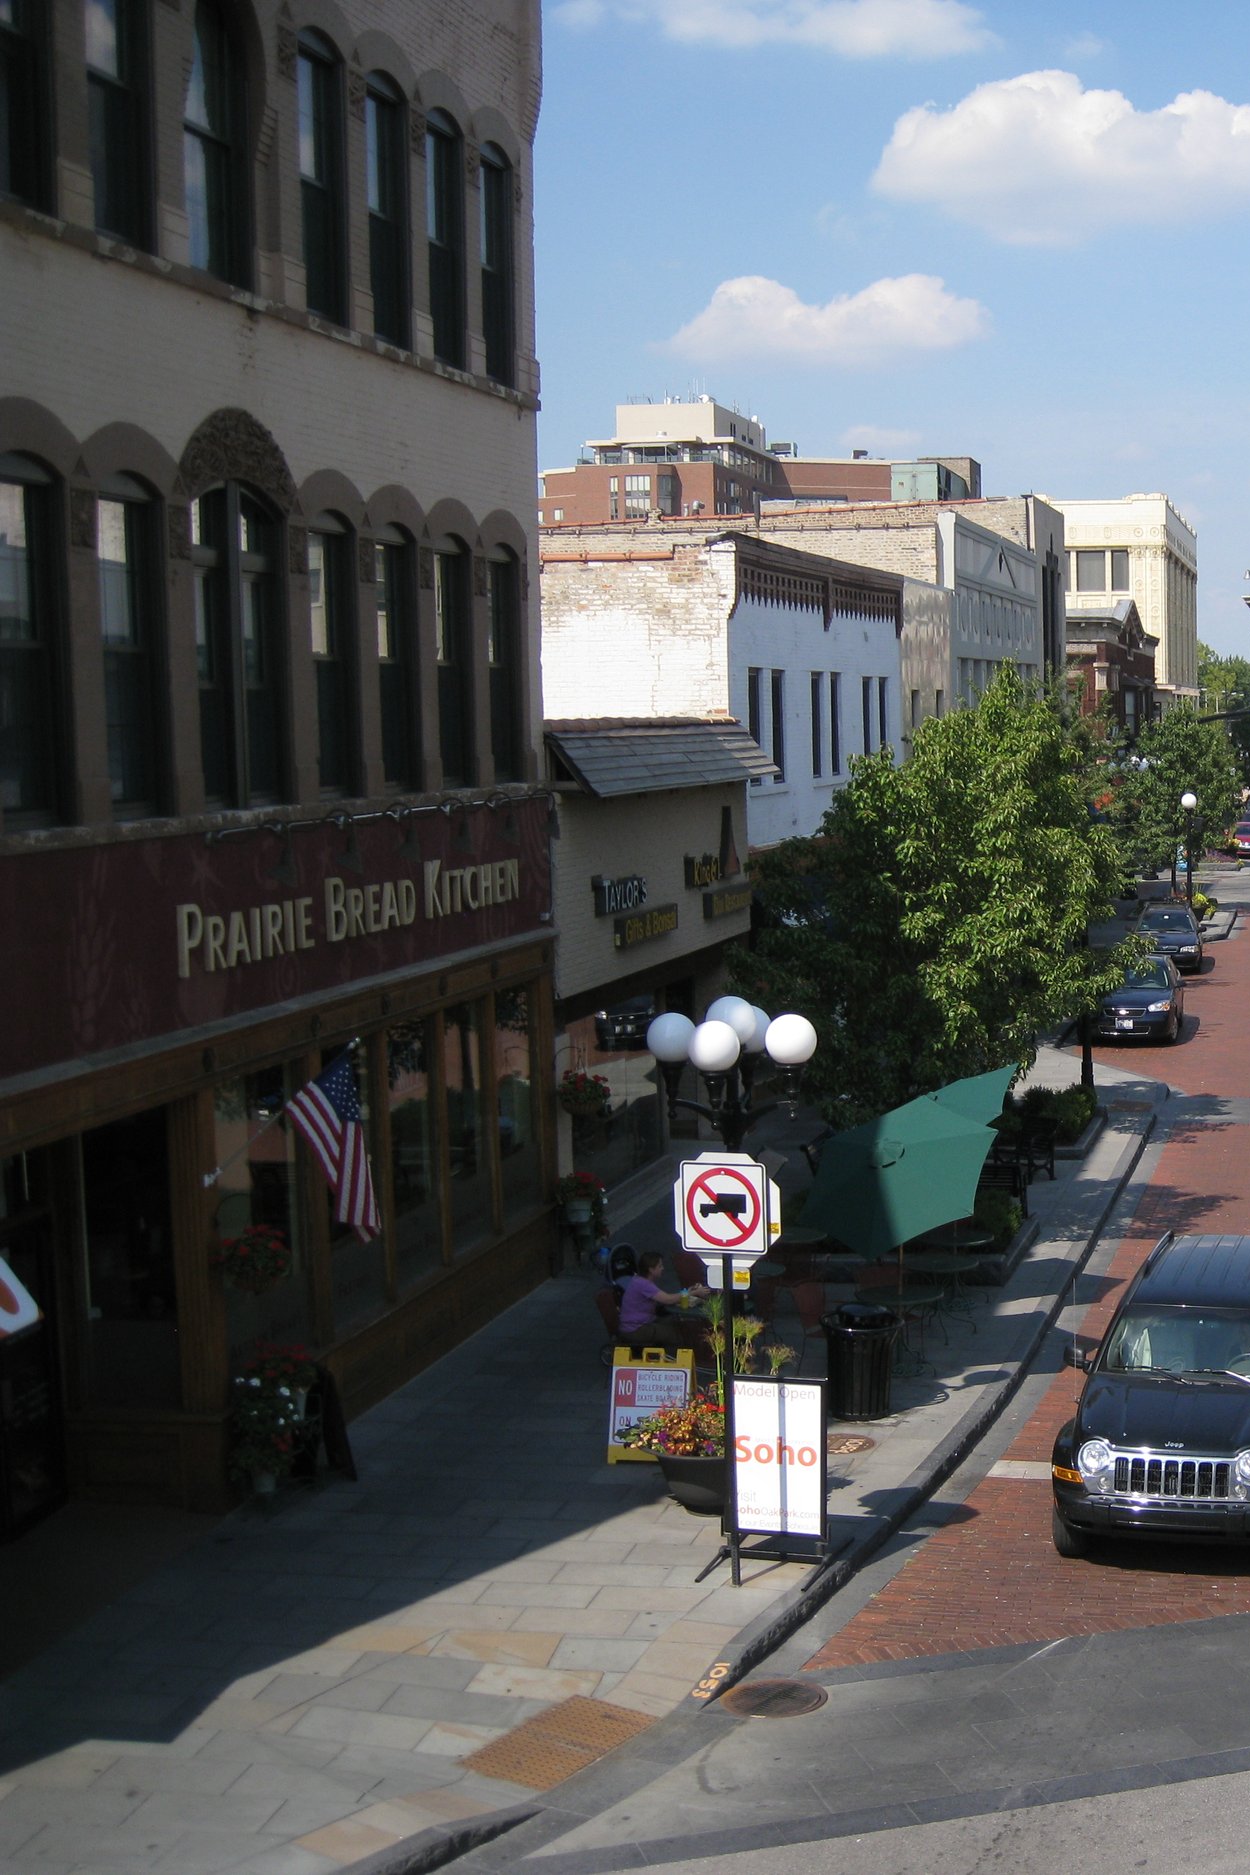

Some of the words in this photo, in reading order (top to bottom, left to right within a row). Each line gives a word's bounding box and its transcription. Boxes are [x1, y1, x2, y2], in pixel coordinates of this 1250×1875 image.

[603, 878, 648, 914] TAYLOR'S
[176, 897, 315, 979] PRAIRIE
[325, 876, 416, 942] BREAD
[424, 858, 519, 920] KITCHEN
[626, 918, 643, 944] Gifts
[645, 914, 652, 937] &
[638, 1373, 662, 1381] BICYCLE
[618, 1379, 633, 1396] NO
[638, 1384, 684, 1392] ROLLERBLADING
[734, 1383, 775, 1398] Model
[780, 1386, 816, 1401] Open
[619, 1416, 632, 1427] ON
[735, 1435, 817, 1467] Soho
[1164, 1441, 1185, 1449] Jeep
